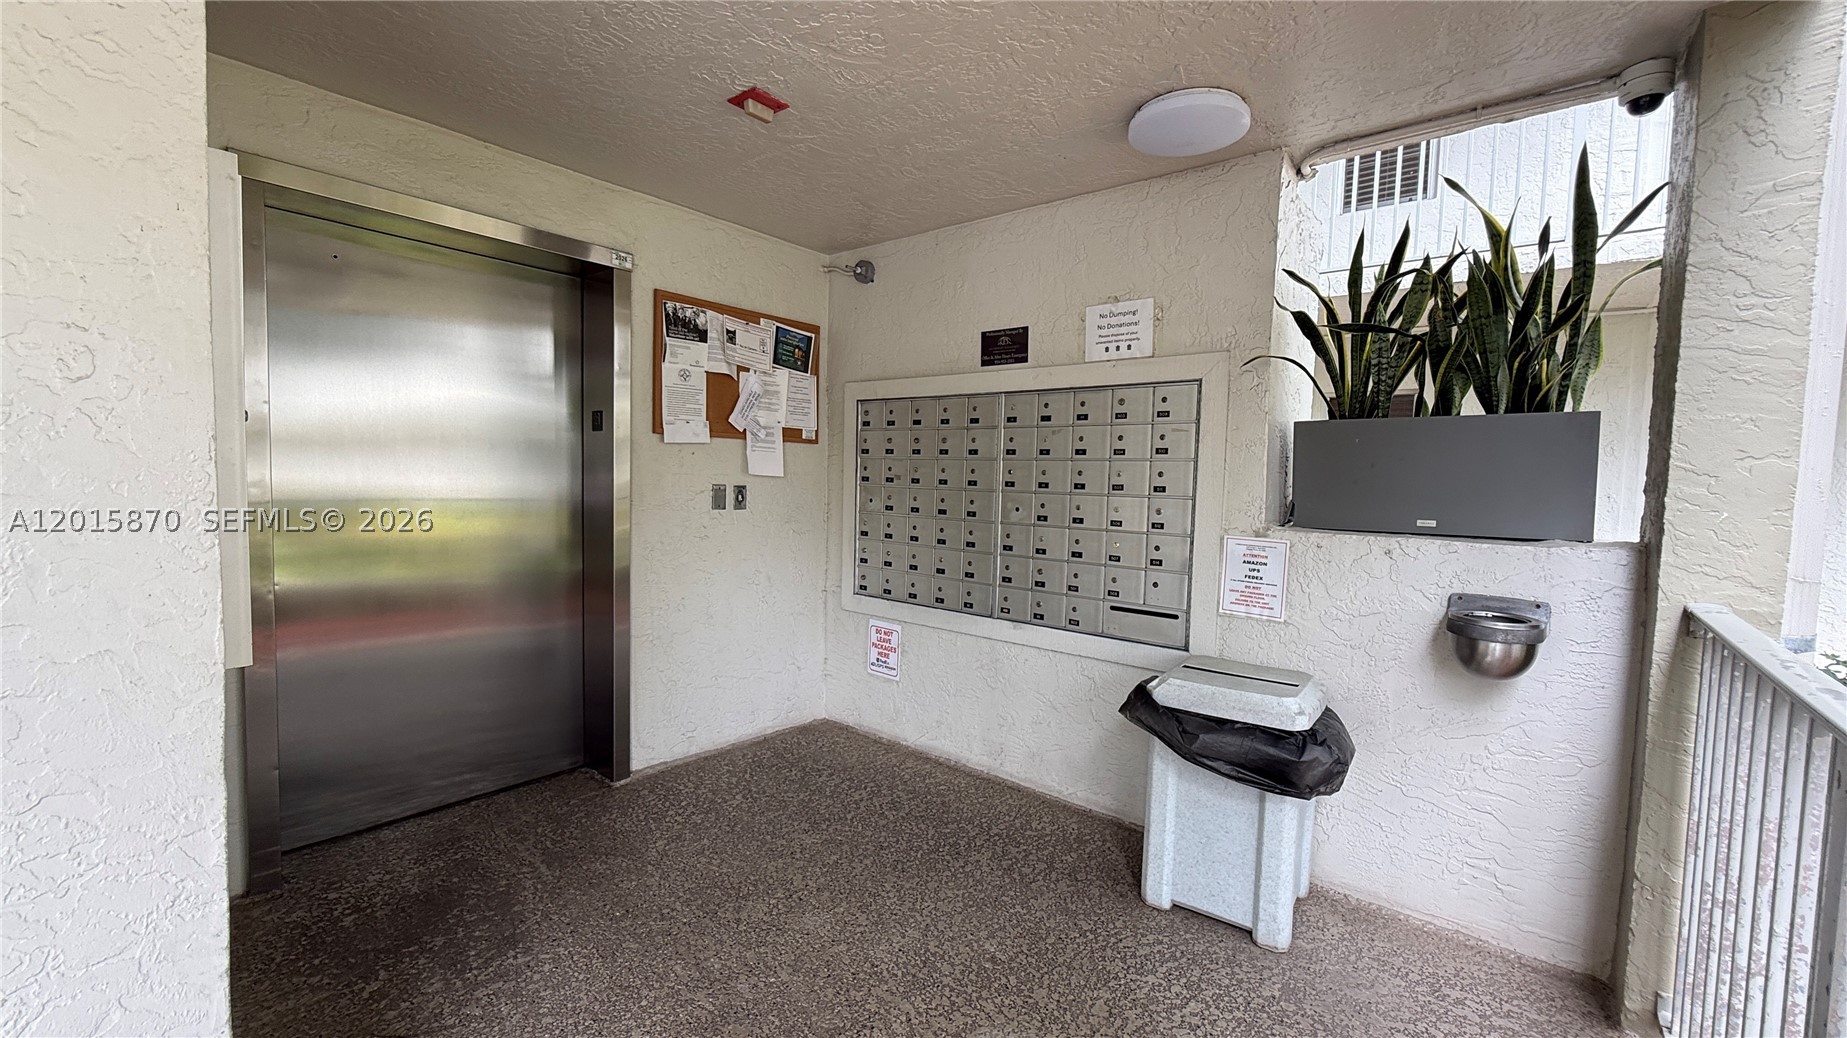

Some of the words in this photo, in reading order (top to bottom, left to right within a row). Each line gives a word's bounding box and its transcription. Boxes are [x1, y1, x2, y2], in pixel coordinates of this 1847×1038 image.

[1109, 309, 1138, 318] Dumping!
[1107, 320, 1140, 330] Donations!
[877, 636, 892, 645] LEAVE
[872, 642, 897, 653] PACKAGES
[877, 651, 890, 659] HERE
